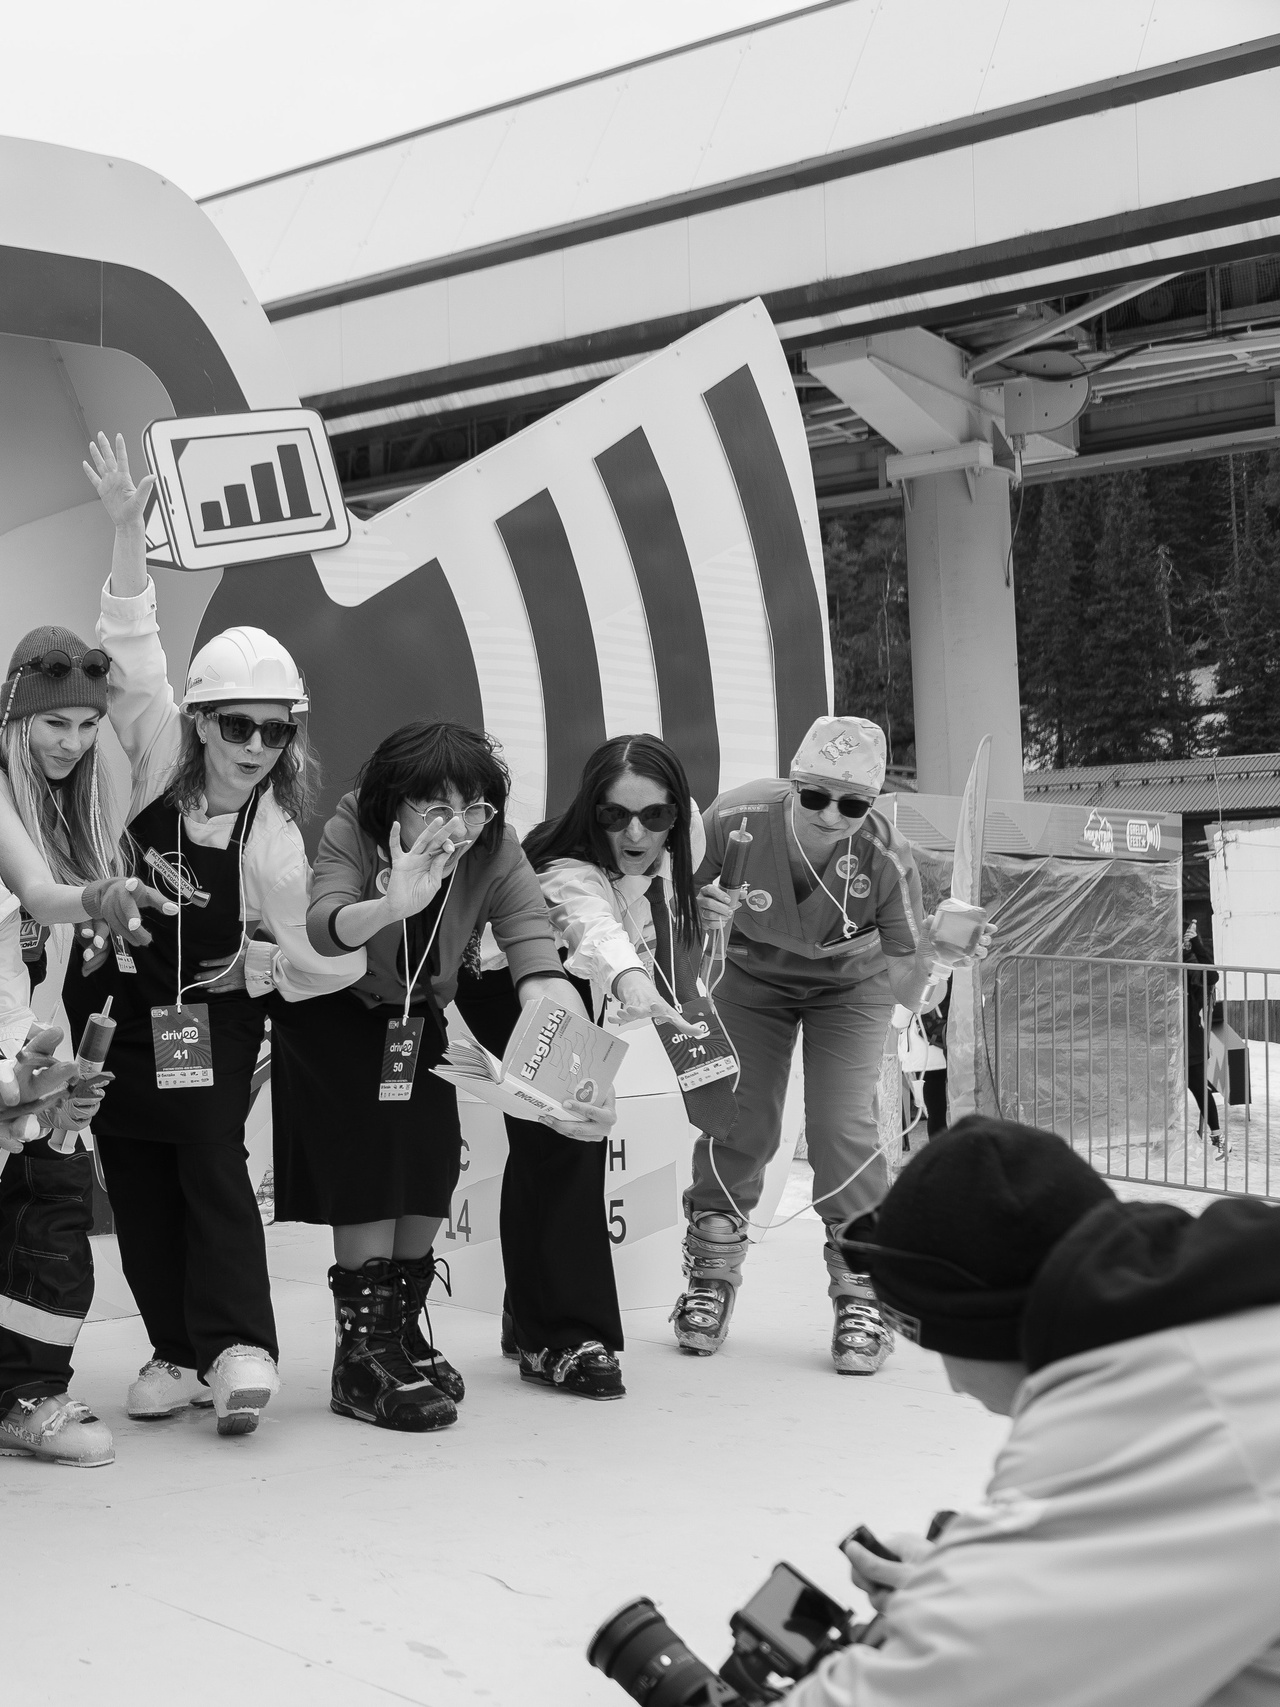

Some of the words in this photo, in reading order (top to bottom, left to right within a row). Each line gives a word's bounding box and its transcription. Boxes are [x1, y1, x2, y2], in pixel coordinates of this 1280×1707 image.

[1130, 835, 1142, 848] FEST
[161, 1028, 199, 1042] drivee
[520, 1008, 567, 1081] English
[173, 1049, 189, 1060] 41
[688, 1045, 706, 1058] 71
[393, 1062, 404, 1072] 50
